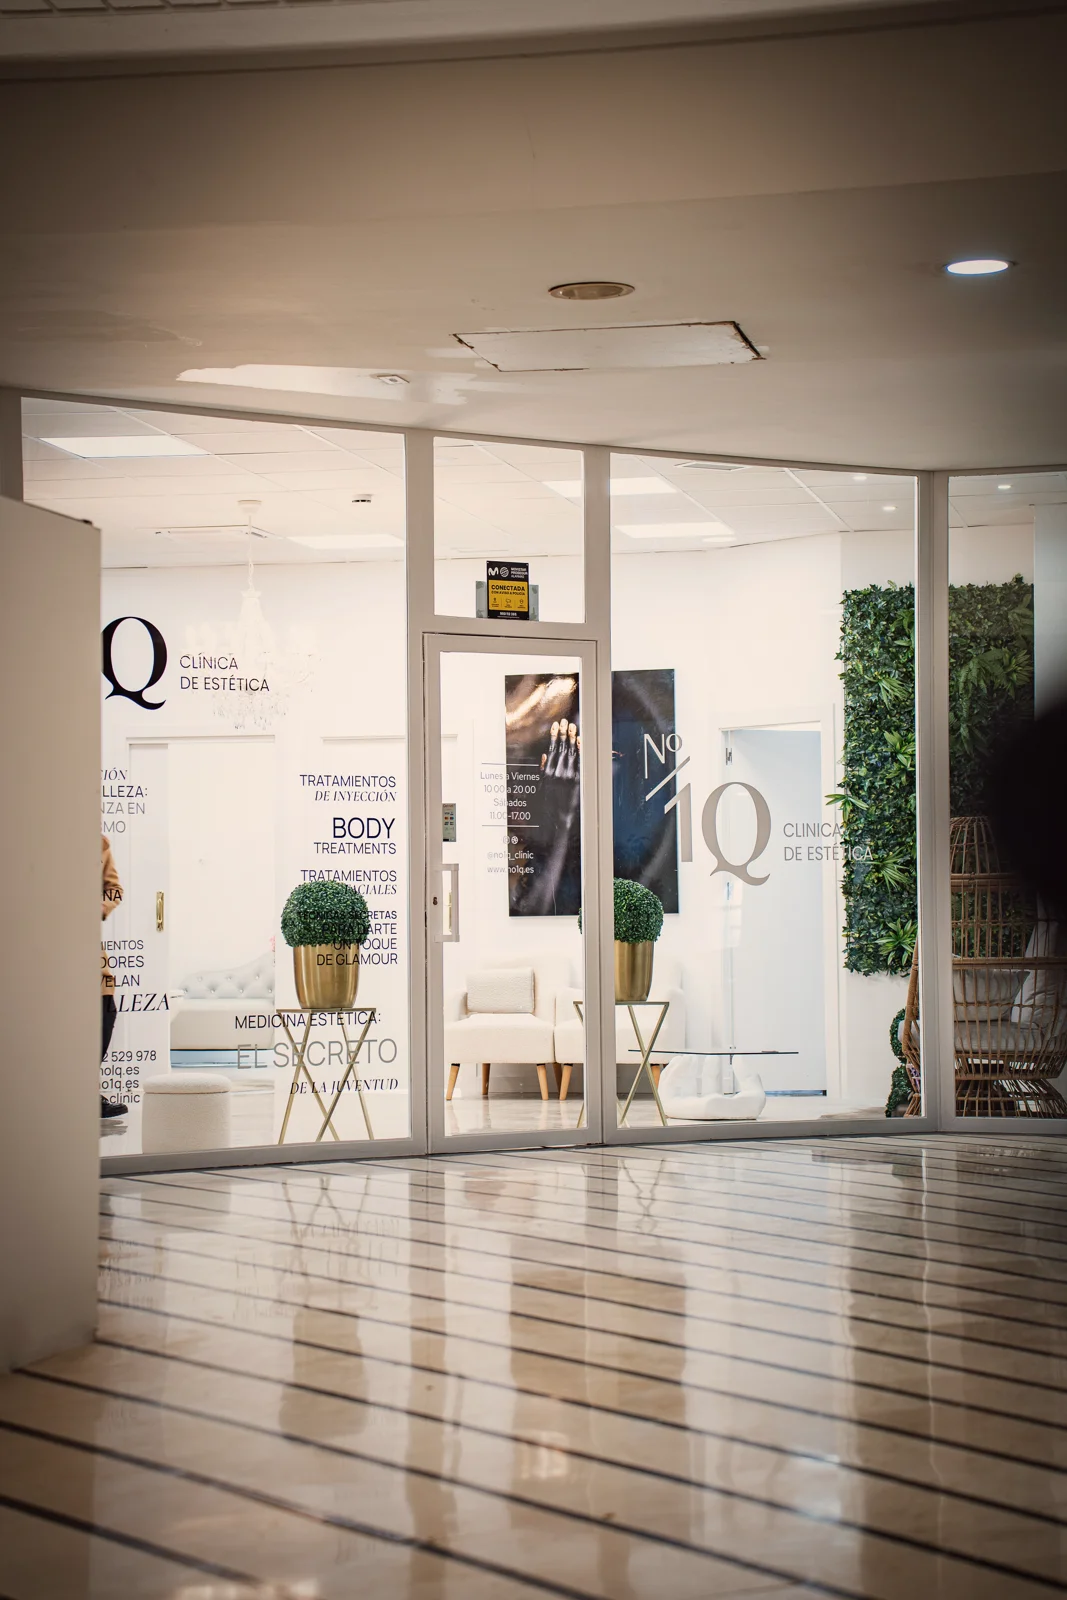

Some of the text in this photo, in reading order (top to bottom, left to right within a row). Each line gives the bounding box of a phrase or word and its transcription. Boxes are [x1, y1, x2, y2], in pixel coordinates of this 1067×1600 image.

[100, 616, 167, 710] Q
[179, 652, 239, 670] CLÍNICA
[180, 674, 270, 692] DE ESTÉTICA
[101, 767, 128, 781] IÓN
[299, 774, 397, 788] TRATAMIENTOS
[480, 771, 504, 780] Lunes
[511, 772, 540, 781] Viernes
[102, 785, 148, 798] LLEZA:
[314, 789, 398, 802] DE INYECCIÓN
[127, 802, 146, 815] EN
[493, 797, 528, 807] Sábados
[101, 820, 126, 834] MO
[332, 817, 396, 839] BODY
[313, 842, 397, 855] TREATMENTS
[783, 842, 874, 861] DE ESTÉTICA
[300, 869, 398, 882] TRATAMIENTOS
[348, 909, 398, 921] SECRETAS
[357, 922, 398, 935] DARTE
[316, 953, 398, 966] DE GLAMOUR
[235, 1012, 306, 1029] MEDICINA
[111, 1050, 133, 1062] 529
[136, 1050, 157, 1061] 978
[237, 1038, 398, 1070] EL SECRETO
[100, 1078, 140, 1092] o1q.es
[289, 1078, 399, 1096] DE LA JUVENTUD
